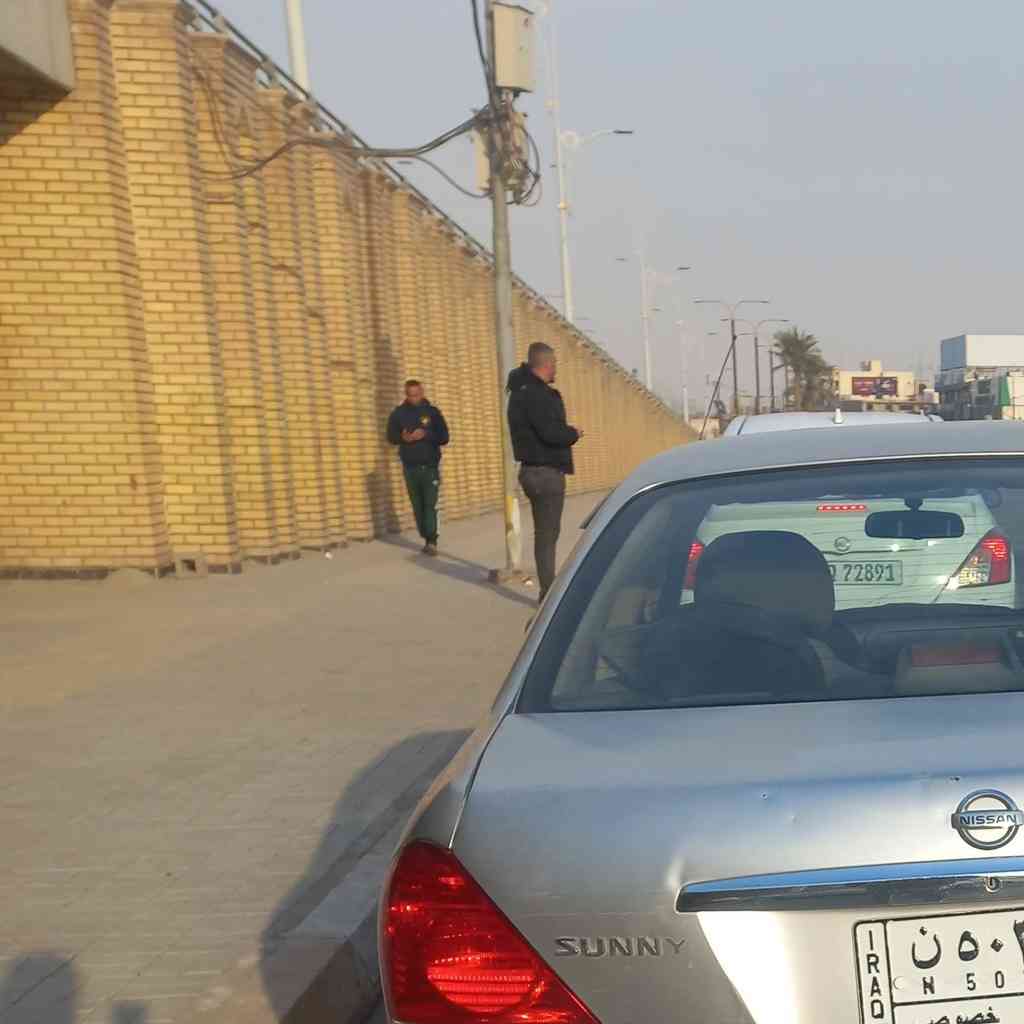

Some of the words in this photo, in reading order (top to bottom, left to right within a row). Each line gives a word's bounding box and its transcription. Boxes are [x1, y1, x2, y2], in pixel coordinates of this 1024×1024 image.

[843, 563, 895, 582] 72891
[960, 814, 1017, 825] NISSAN
[554, 936, 686, 958] SUNNY
[867, 929, 885, 1020] IRAQ
